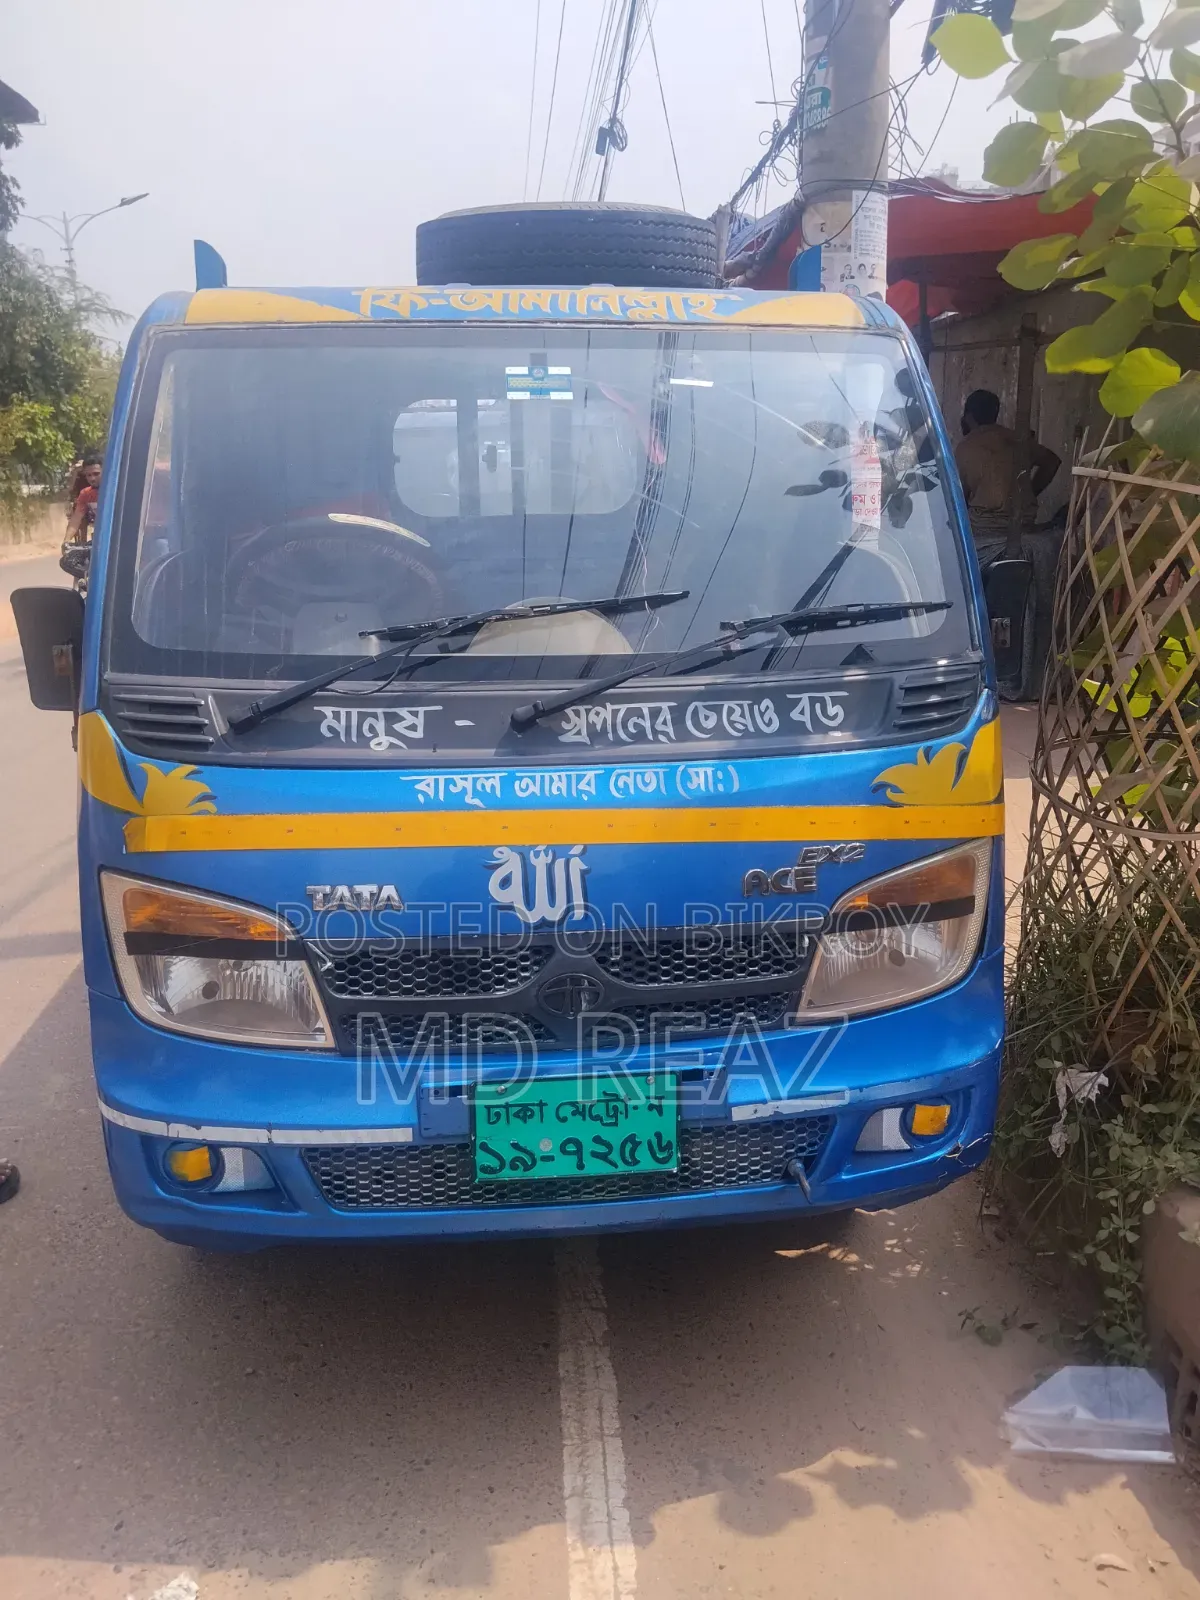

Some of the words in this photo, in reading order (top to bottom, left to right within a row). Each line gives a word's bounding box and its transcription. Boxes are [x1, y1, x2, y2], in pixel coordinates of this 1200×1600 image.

[314, 706, 443, 751] মানুষ
[514, 770, 604, 801] আমার
[609, 768, 669, 798] নেতা
[742, 865, 818, 898] ACE
[798, 841, 866, 867] EX2
[306, 884, 404, 912] TATA
[484, 1099, 549, 1125] ঢাকা
[479, 1131, 675, 1175] ১৯-৭২৫৬
